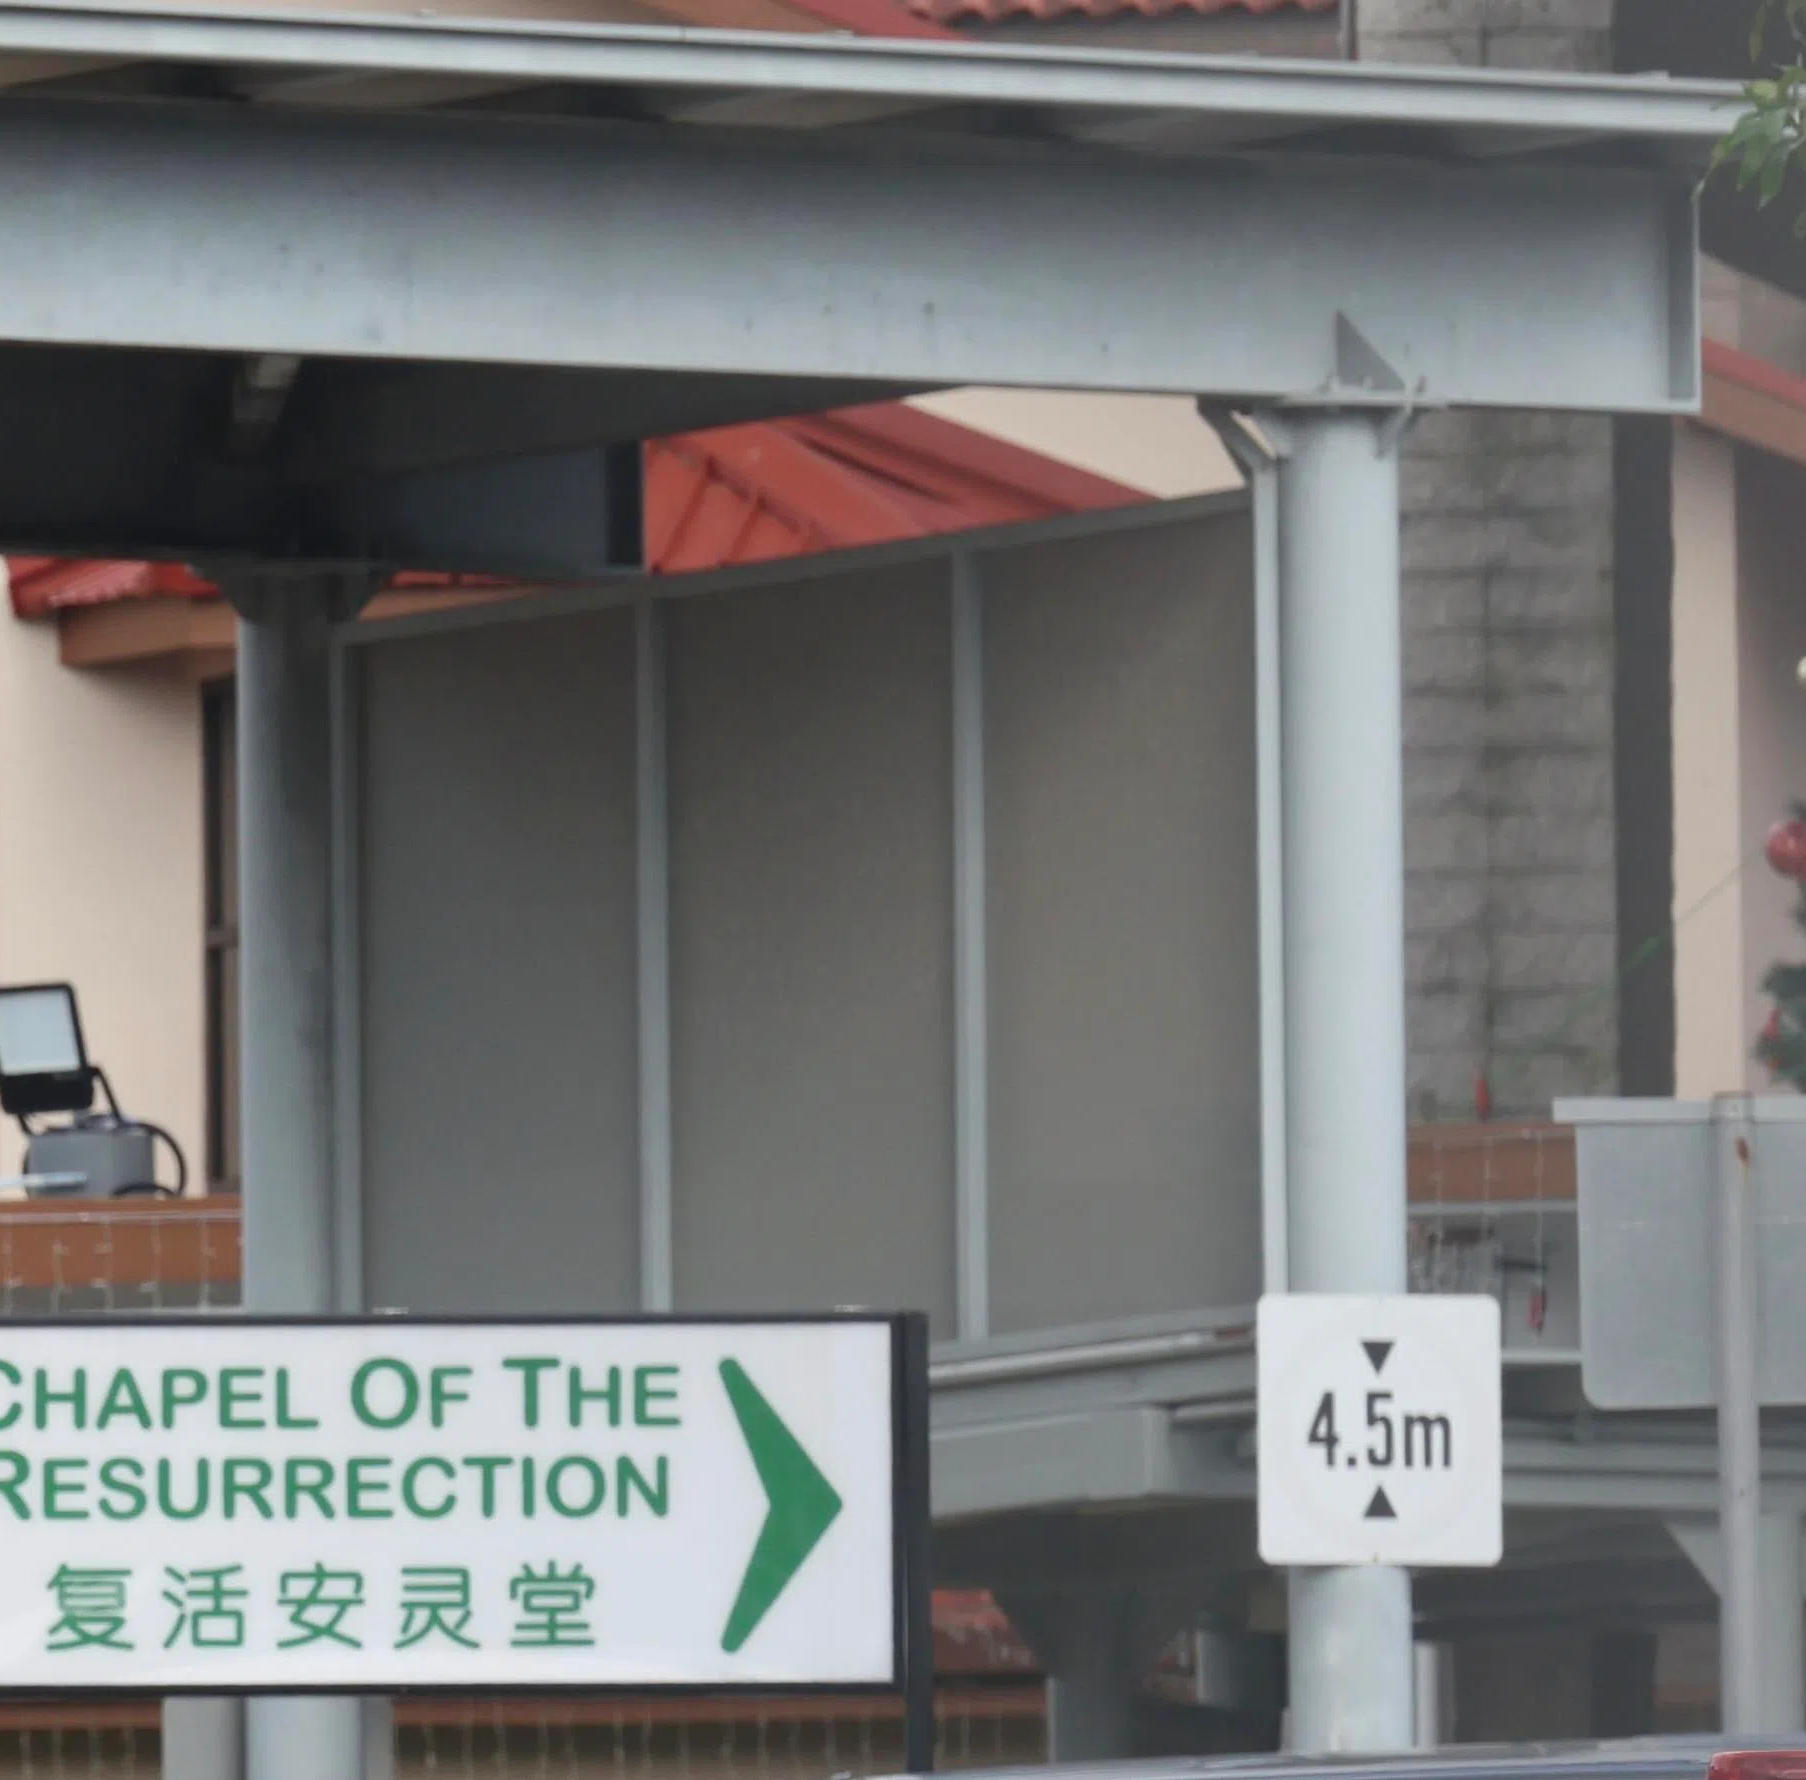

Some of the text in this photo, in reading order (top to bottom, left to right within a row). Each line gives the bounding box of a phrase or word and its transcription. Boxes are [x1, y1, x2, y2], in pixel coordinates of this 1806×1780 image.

[348, 1357, 472, 1432] OF
[501, 1355, 683, 1429] THE
[1307, 1391, 1452, 1470] 4.5m
[45, 1558, 597, 1654] 复活安灵堂
